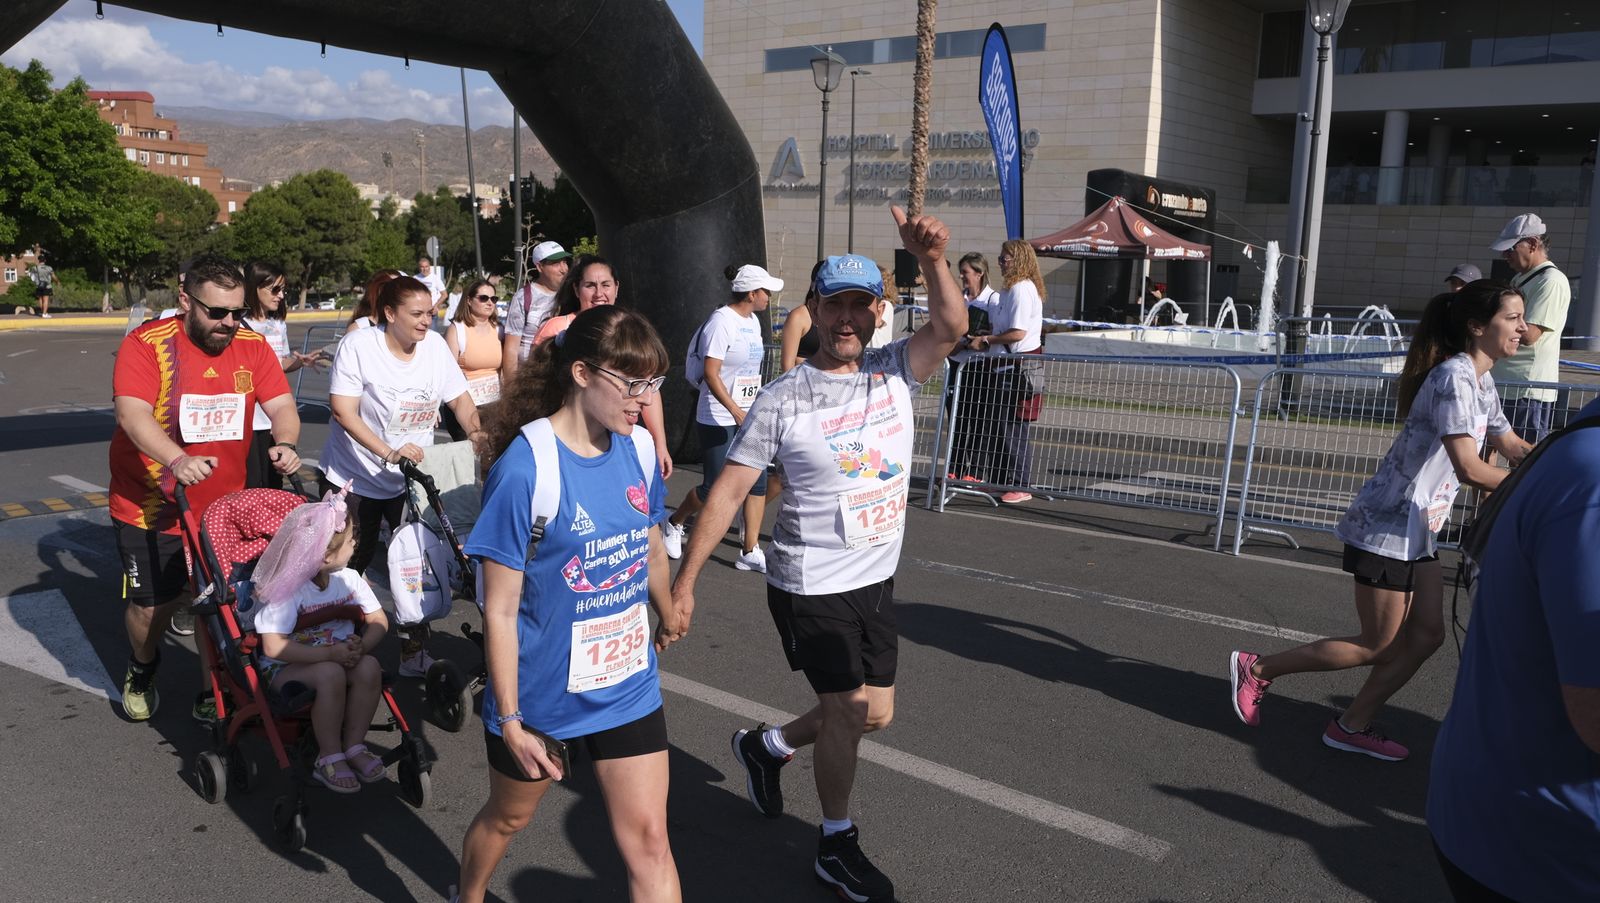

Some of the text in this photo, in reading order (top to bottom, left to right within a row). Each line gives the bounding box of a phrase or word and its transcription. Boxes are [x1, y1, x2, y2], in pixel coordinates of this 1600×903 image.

[189, 410, 237, 425] 1187
[399, 410, 435, 423] 1188
[857, 493, 906, 529] 1234
[571, 518, 595, 532] ALTEA
[585, 540, 596, 559] II
[597, 533, 628, 552] Runner
[608, 543, 630, 566] azul
[587, 625, 645, 666] 1235
